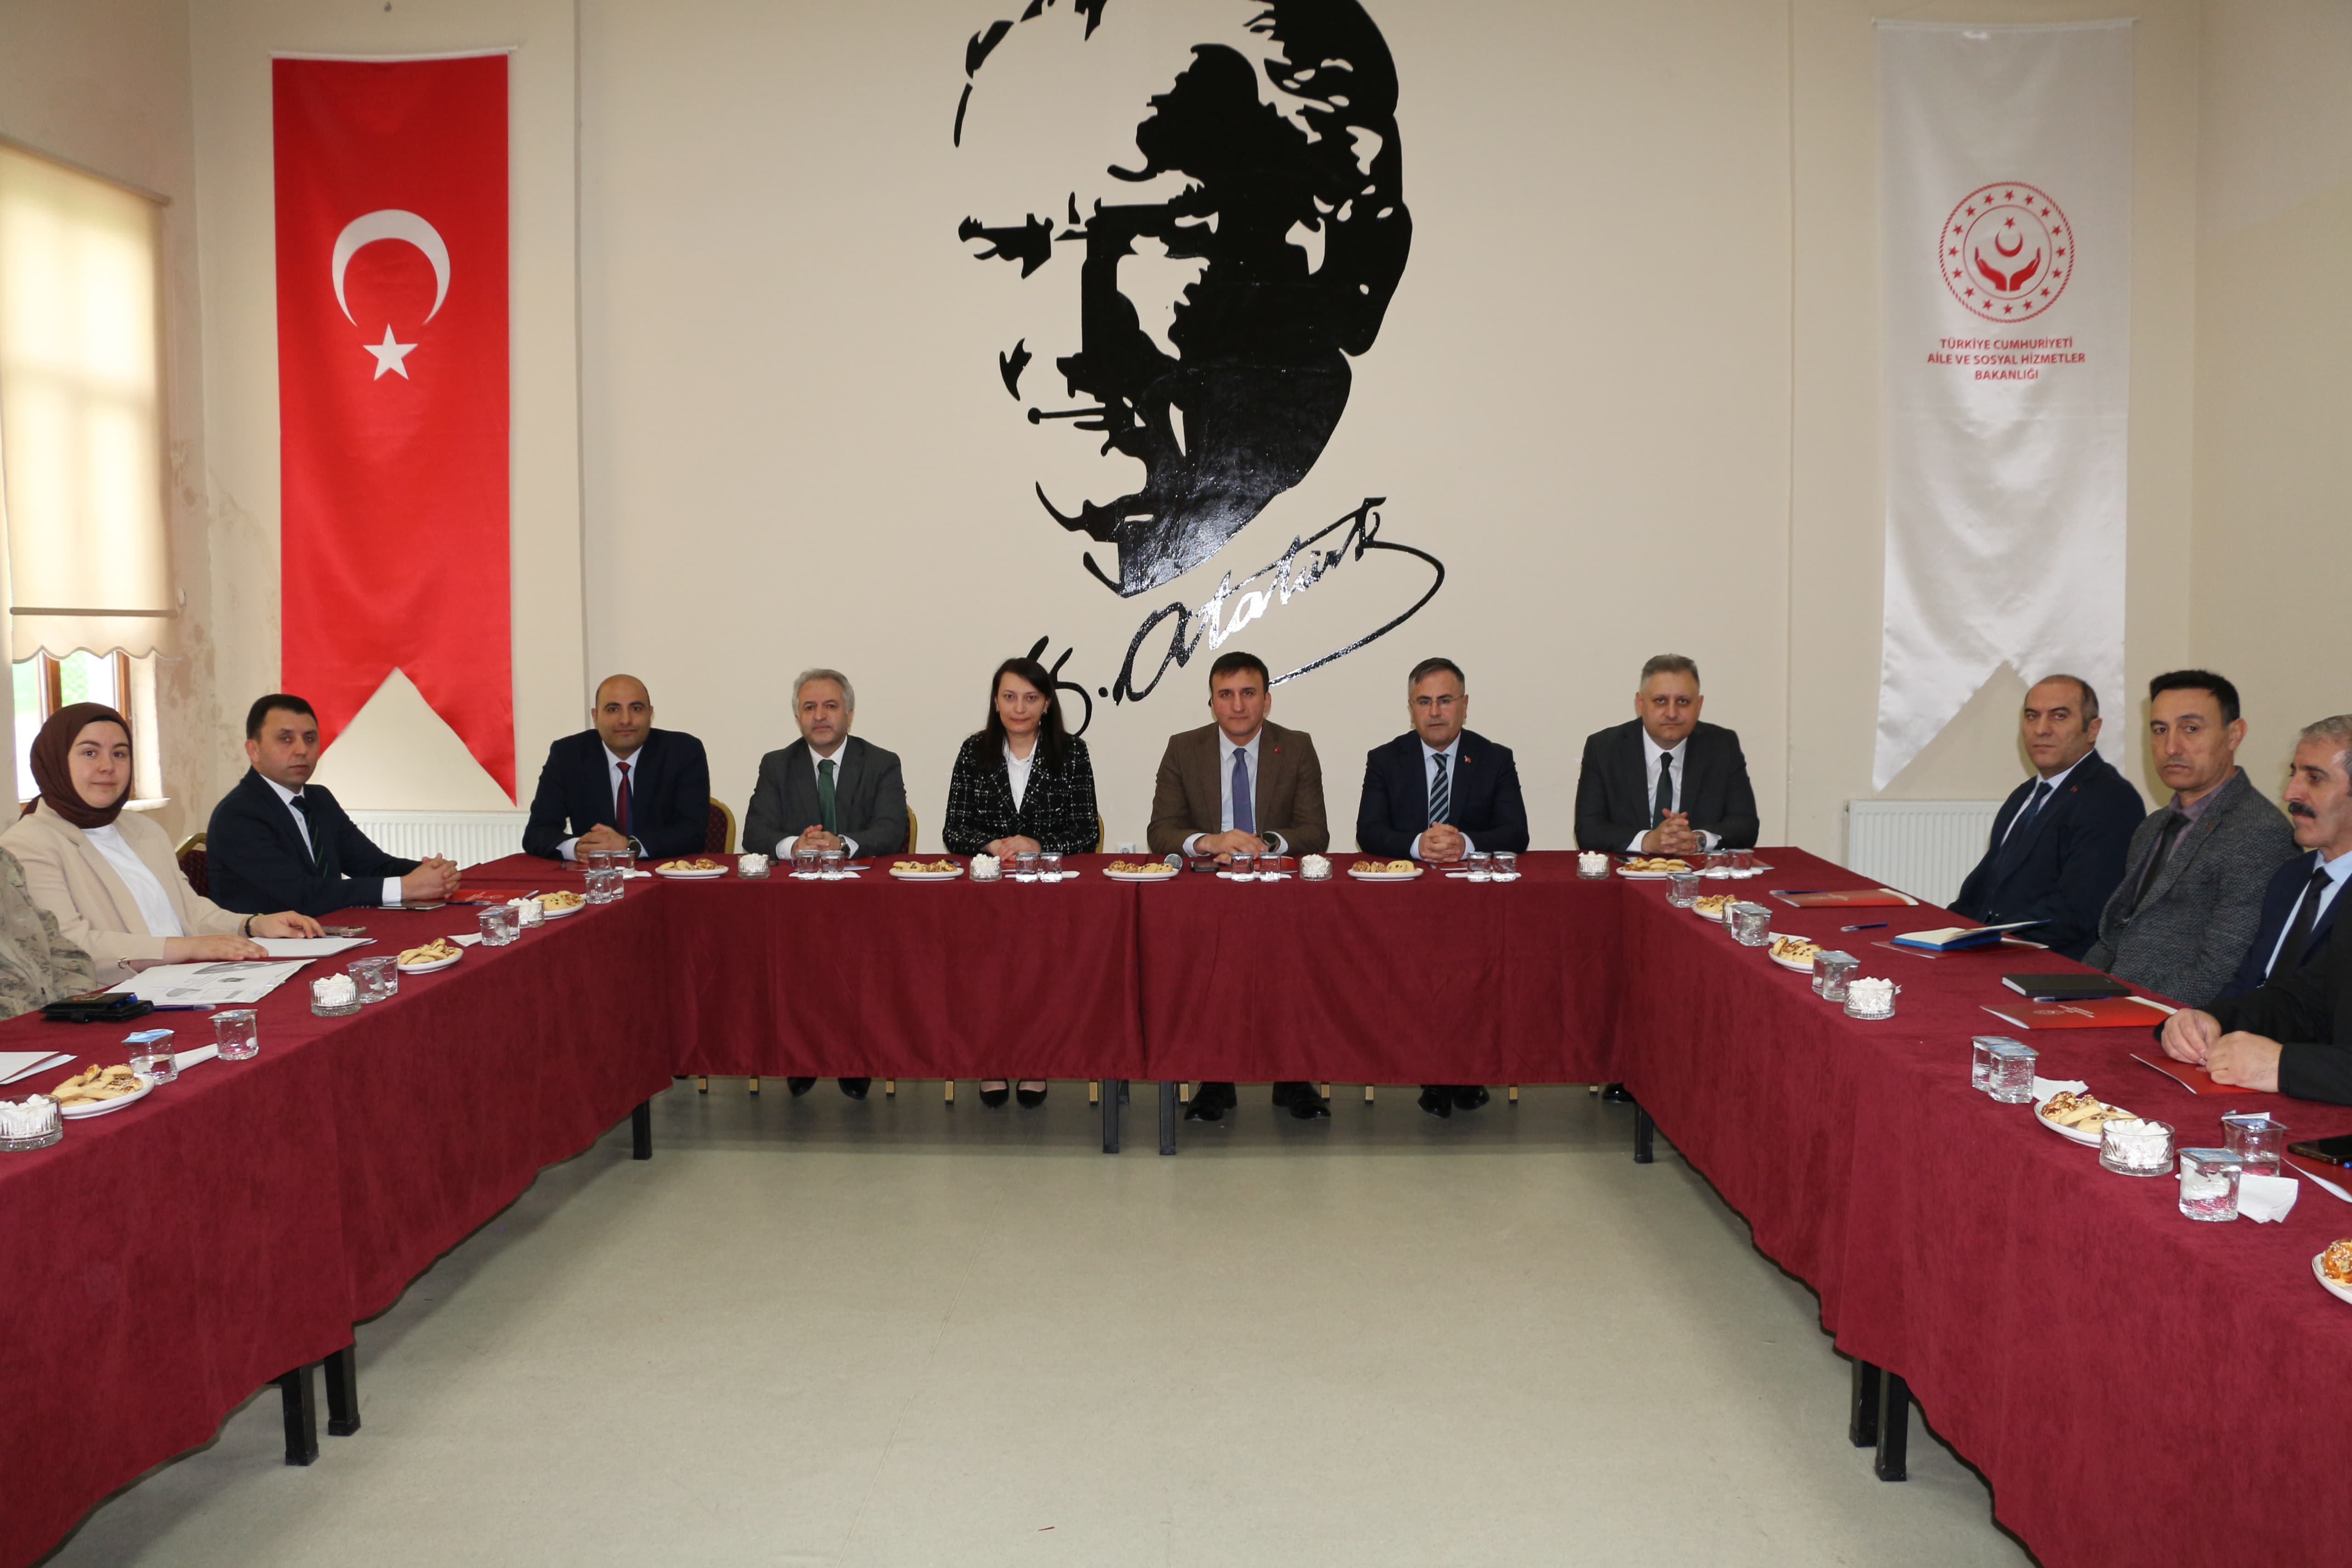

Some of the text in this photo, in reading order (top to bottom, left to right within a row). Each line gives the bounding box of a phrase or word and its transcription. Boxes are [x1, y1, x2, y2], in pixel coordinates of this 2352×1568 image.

[1940, 336, 2073, 351] TÜRKİYE CUMHURİYETİ
[1927, 352, 2086, 365] AİLE VE SOSYAL HİZMETLER
[1975, 367, 2038, 380] BAKANLIĞI
